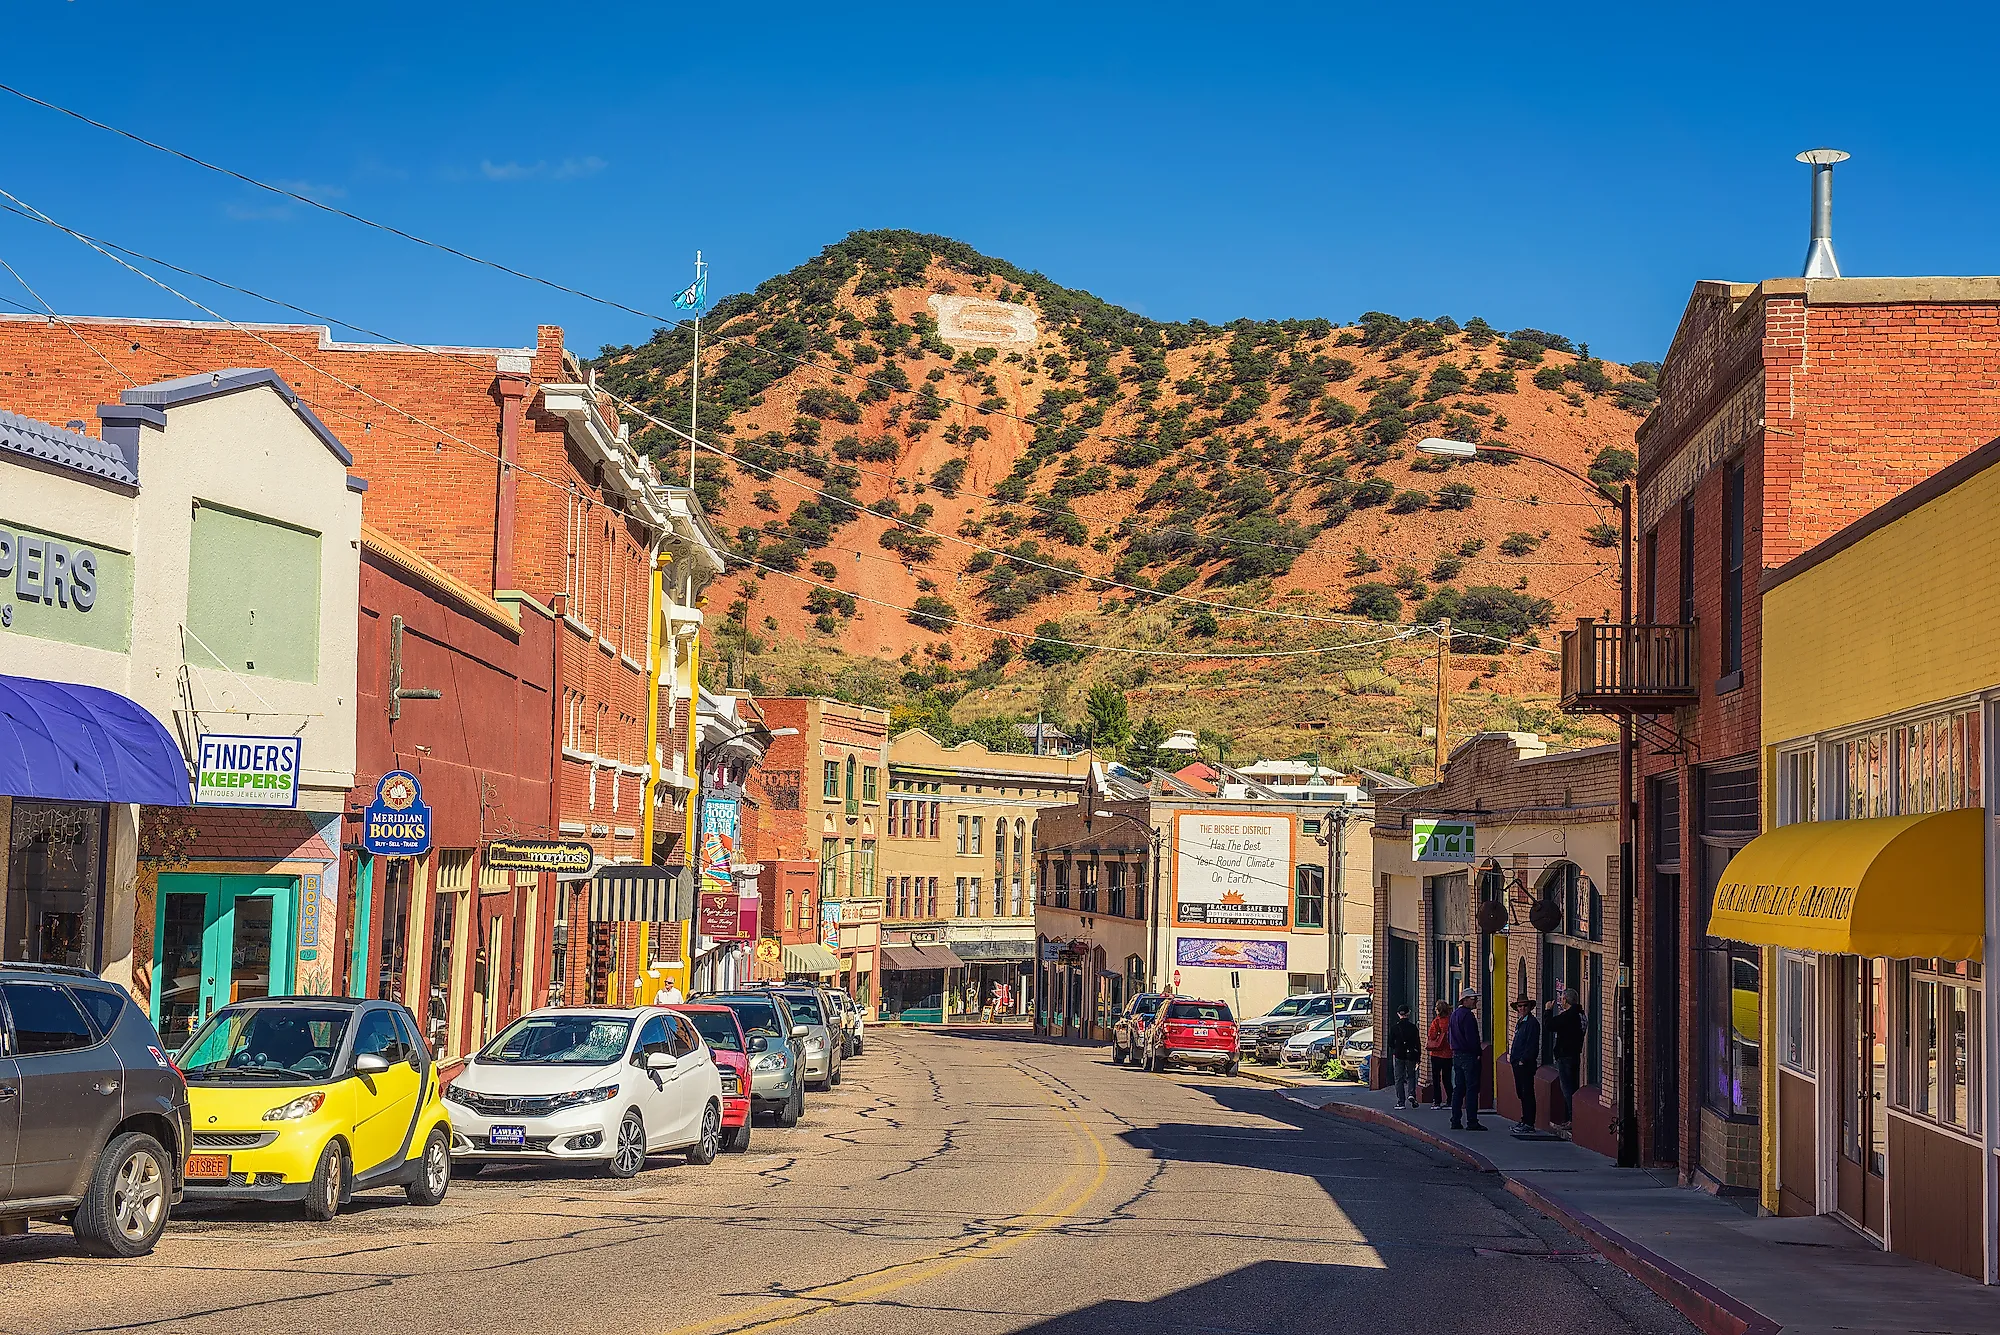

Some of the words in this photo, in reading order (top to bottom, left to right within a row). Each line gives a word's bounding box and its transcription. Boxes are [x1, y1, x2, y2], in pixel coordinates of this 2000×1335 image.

[202, 743, 294, 772] FINDERS
[200, 771, 292, 790] KEEPERS
[199, 789, 235, 797] ANTIQUES
[237, 790, 267, 799] JEWELRY
[269, 791, 290, 799] GIFTS
[706, 802, 735, 811] BISBEE
[706, 809, 734, 819] 1000
[707, 821, 731, 830] STAIR
[1200, 824, 1213, 834] THE
[1214, 824, 1240, 835] BISBEE
[1242, 825, 1272, 836] DISTRICT
[369, 823, 425, 841] BOOKS
[1227, 839, 1241, 851] The
[1243, 839, 1261, 851] Best
[1216, 855, 1243, 867] Round
[1246, 856, 1275, 868] Climate
[1211, 871, 1223, 883] On
[1788, 885, 1800, 916] &
[304, 877, 317, 943] BOOKS
[1206, 903, 1242, 911] PRACTICE
[1246, 904, 1263, 912] SAFE
[1236, 918, 1267, 926] ARIZONA
[1270, 919, 1283, 927] USA
[1181, 951, 1196, 962] JEEP
[1196, 941, 1216, 956] TOURS
[492, 1128, 523, 1136] LAWLEY
[189, 1160, 224, 1173] BISBEE
